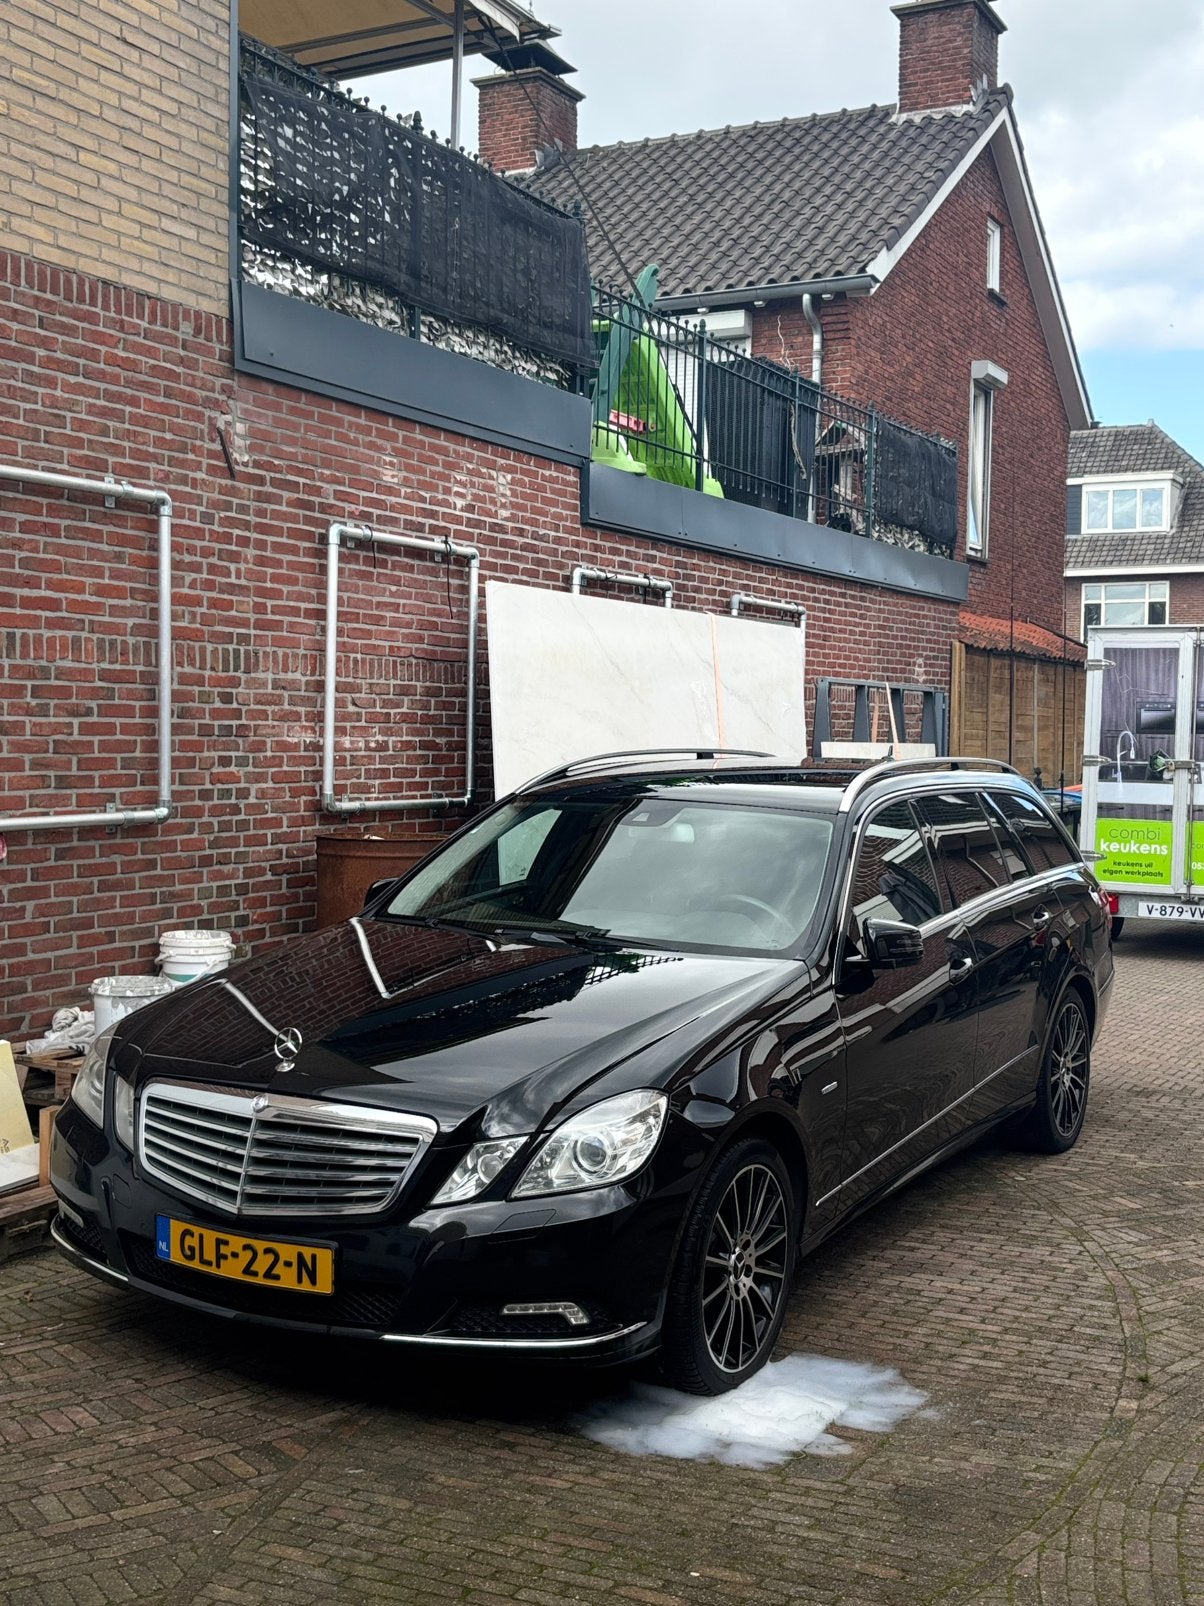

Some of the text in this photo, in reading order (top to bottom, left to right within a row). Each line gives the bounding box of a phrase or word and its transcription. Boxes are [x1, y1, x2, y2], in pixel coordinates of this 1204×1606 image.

[1109, 827, 1161, 840] combi
[1100, 838, 1168, 855] keukens
[1113, 860, 1143, 868] keukens
[1102, 867, 1164, 878] eigen werkplaats
[159, 1228, 317, 1287] NL GLF-22-N
